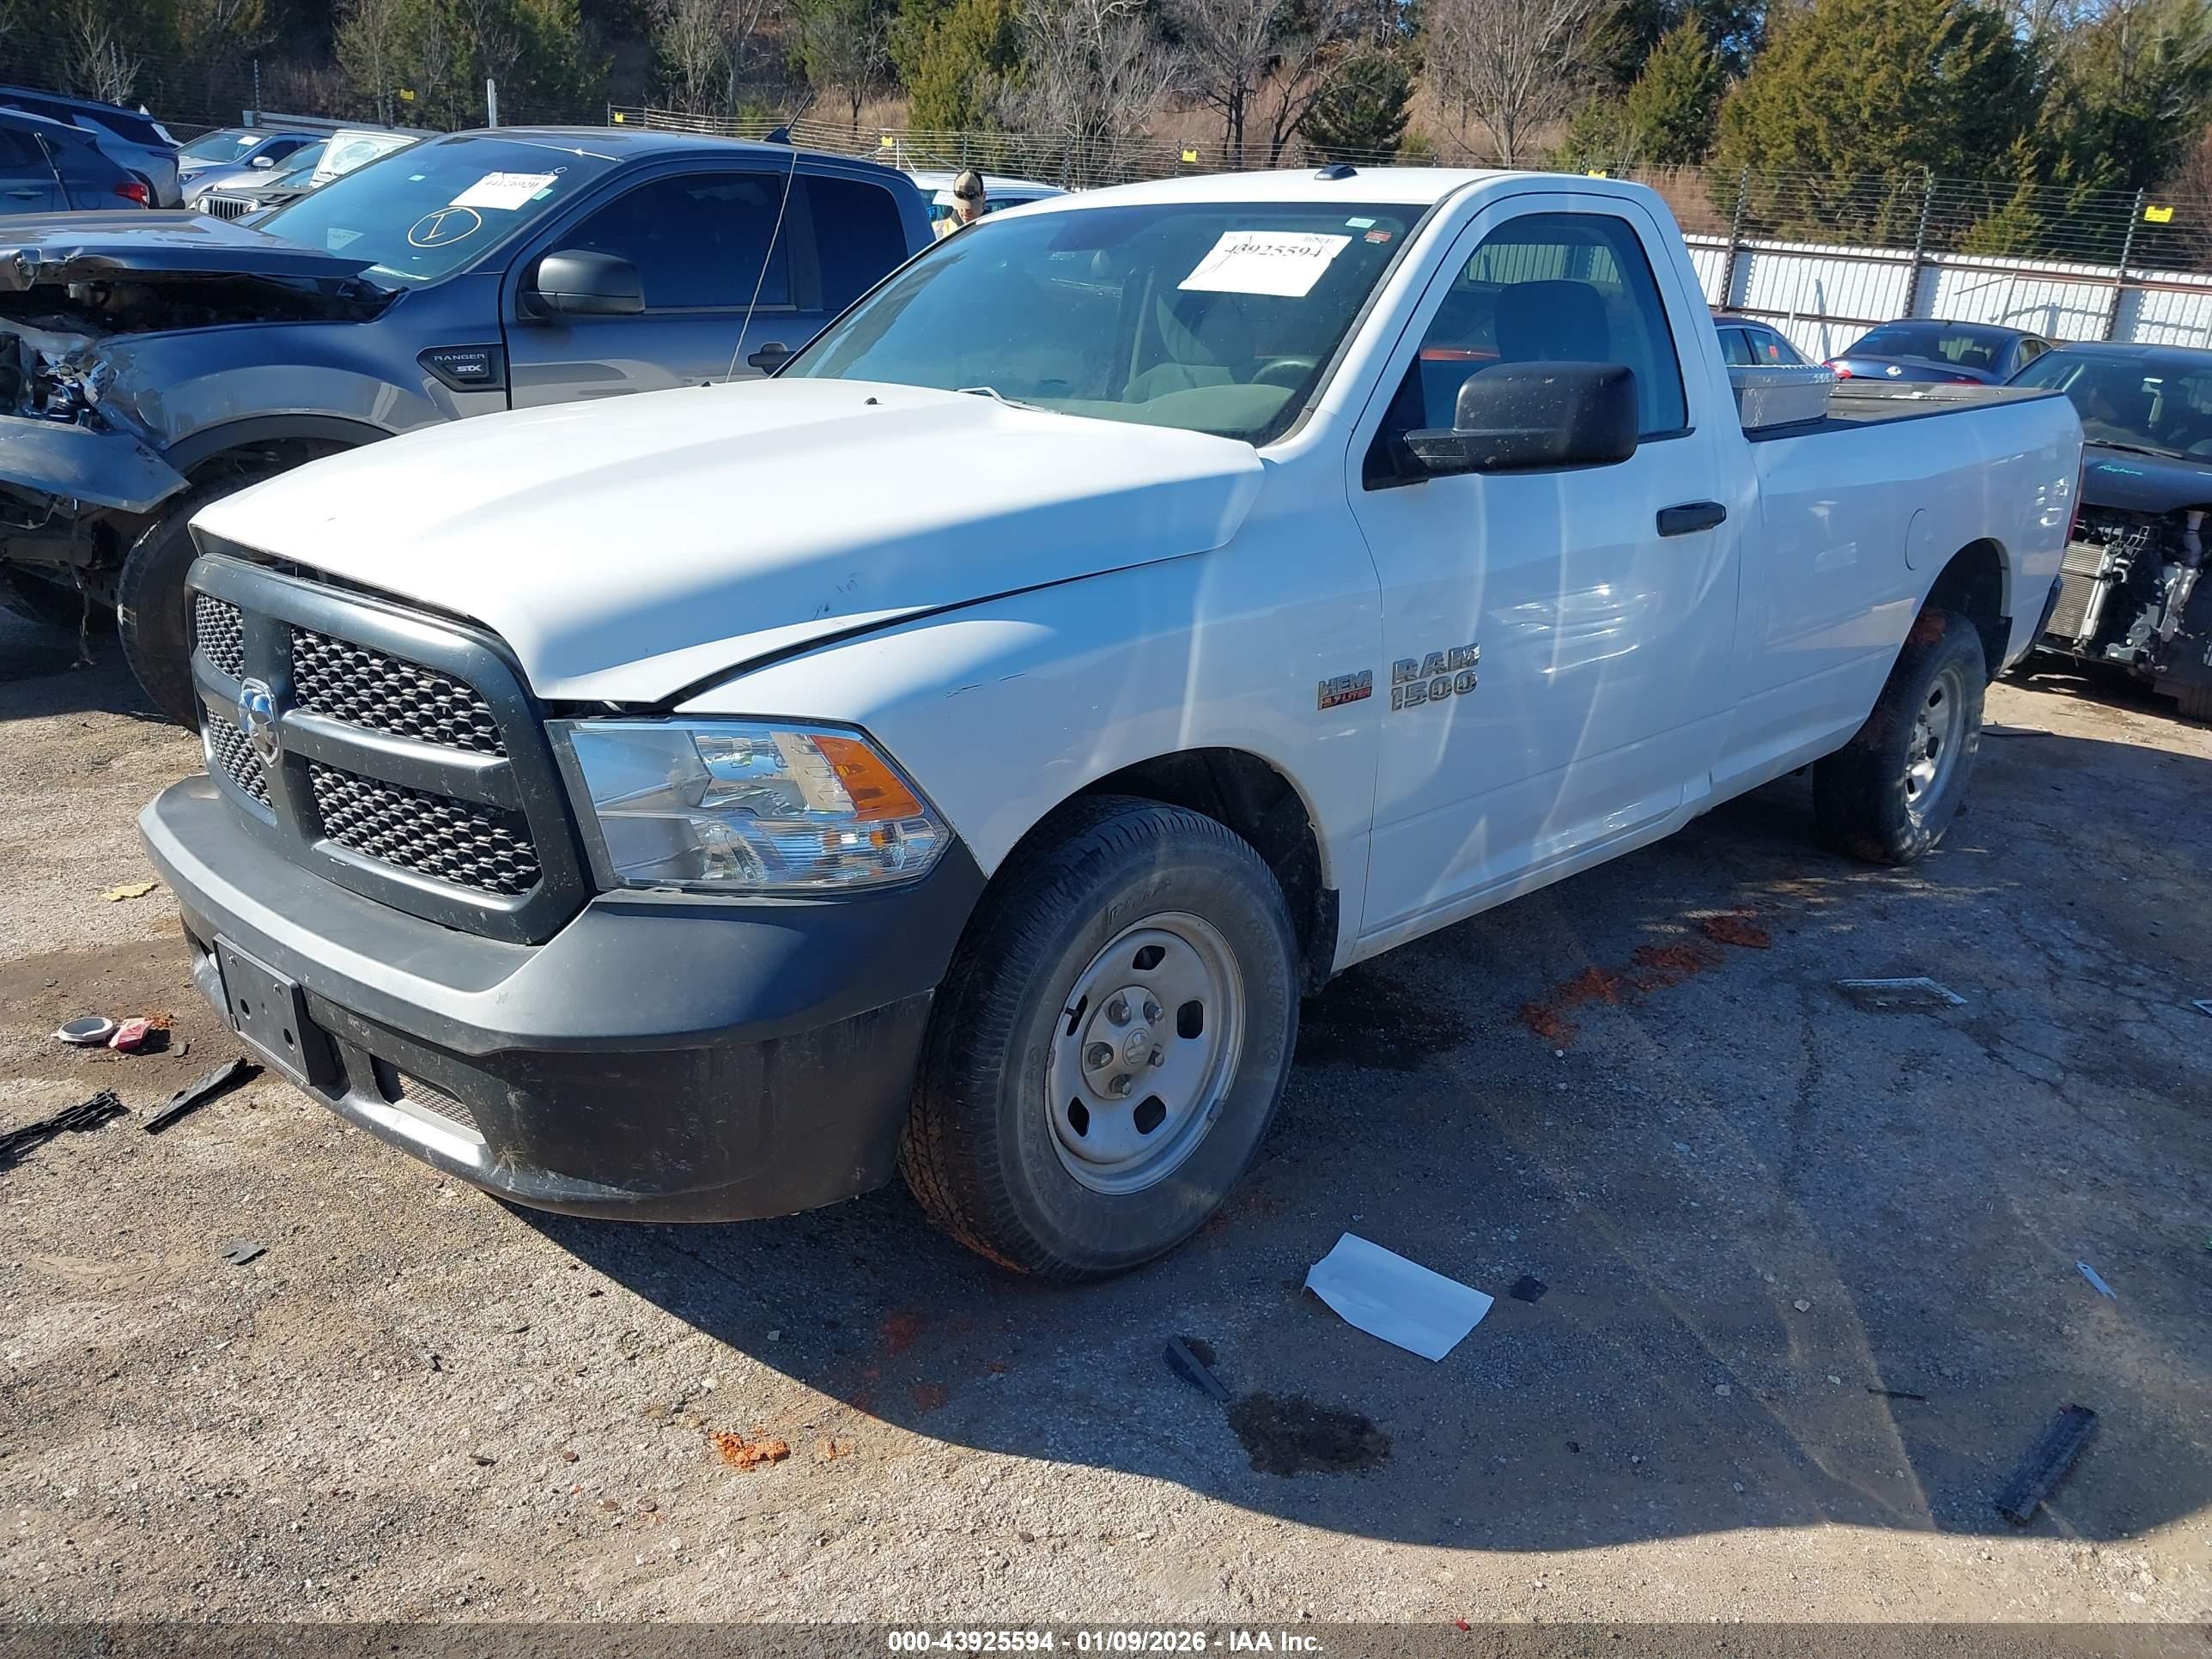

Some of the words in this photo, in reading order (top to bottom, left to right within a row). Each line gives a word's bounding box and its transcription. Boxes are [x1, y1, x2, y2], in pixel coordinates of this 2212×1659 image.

[1224, 243, 1324, 258] 43925594
[434, 353, 485, 362] RANGER
[456, 364, 483, 373] STX
[1391, 643, 1481, 685] RAM
[1341, 687, 1371, 704] LITER
[1390, 670, 1479, 712] 1500
